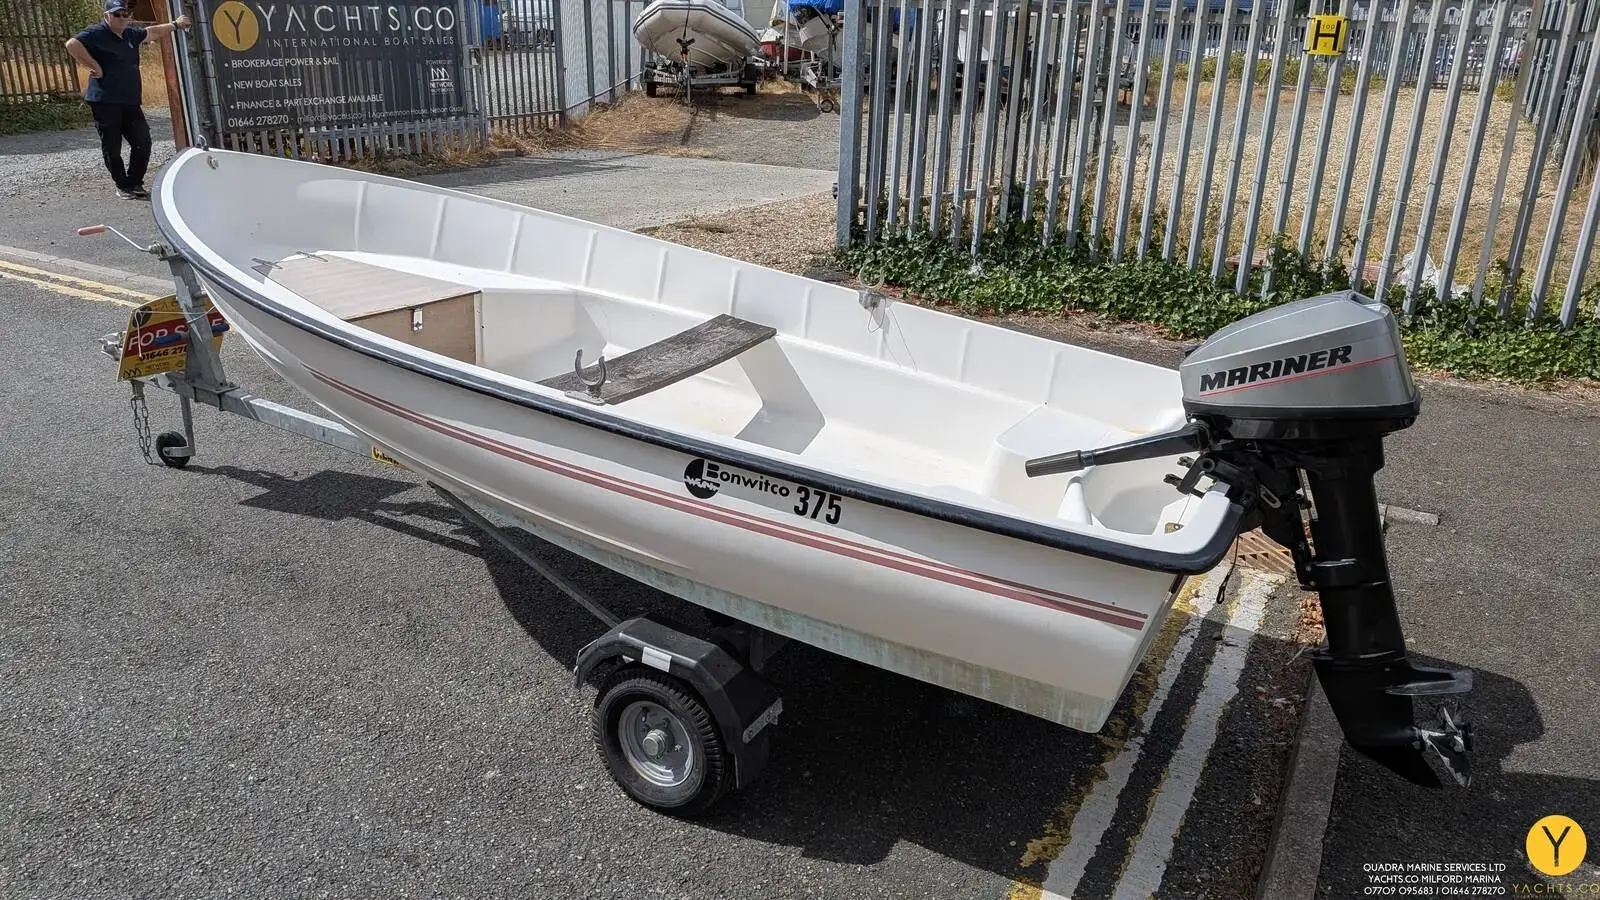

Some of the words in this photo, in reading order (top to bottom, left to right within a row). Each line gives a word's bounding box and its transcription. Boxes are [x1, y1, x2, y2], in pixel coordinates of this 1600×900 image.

[257, 5, 455, 32] YACHTS.CO
[266, 37, 377, 48] INTERNATIONAL
[384, 36, 415, 46] BOAT
[422, 36, 454, 45] SALES
[1312, 20, 1341, 51] H
[231, 58, 284, 69] BROKERAGE
[284, 57, 314, 67] POWER
[315, 57, 322, 66] &
[323, 56, 340, 66] SAIL
[233, 80, 254, 89] NEW
[255, 79, 278, 89] BOAT
[279, 78, 302, 88] SALES
[236, 99, 275, 110] FINANCE
[275, 99, 282, 108] &
[283, 98, 302, 108] PART
[303, 95, 347, 106] EXCHANGE
[347, 93, 384, 104] AVAILABLE
[227, 116, 255, 128] 01646
[256, 114, 289, 126] 278270
[1199, 345, 1352, 393] MARINER
[702, 459, 790, 497] Bonwitco
[794, 486, 842, 525] 375
